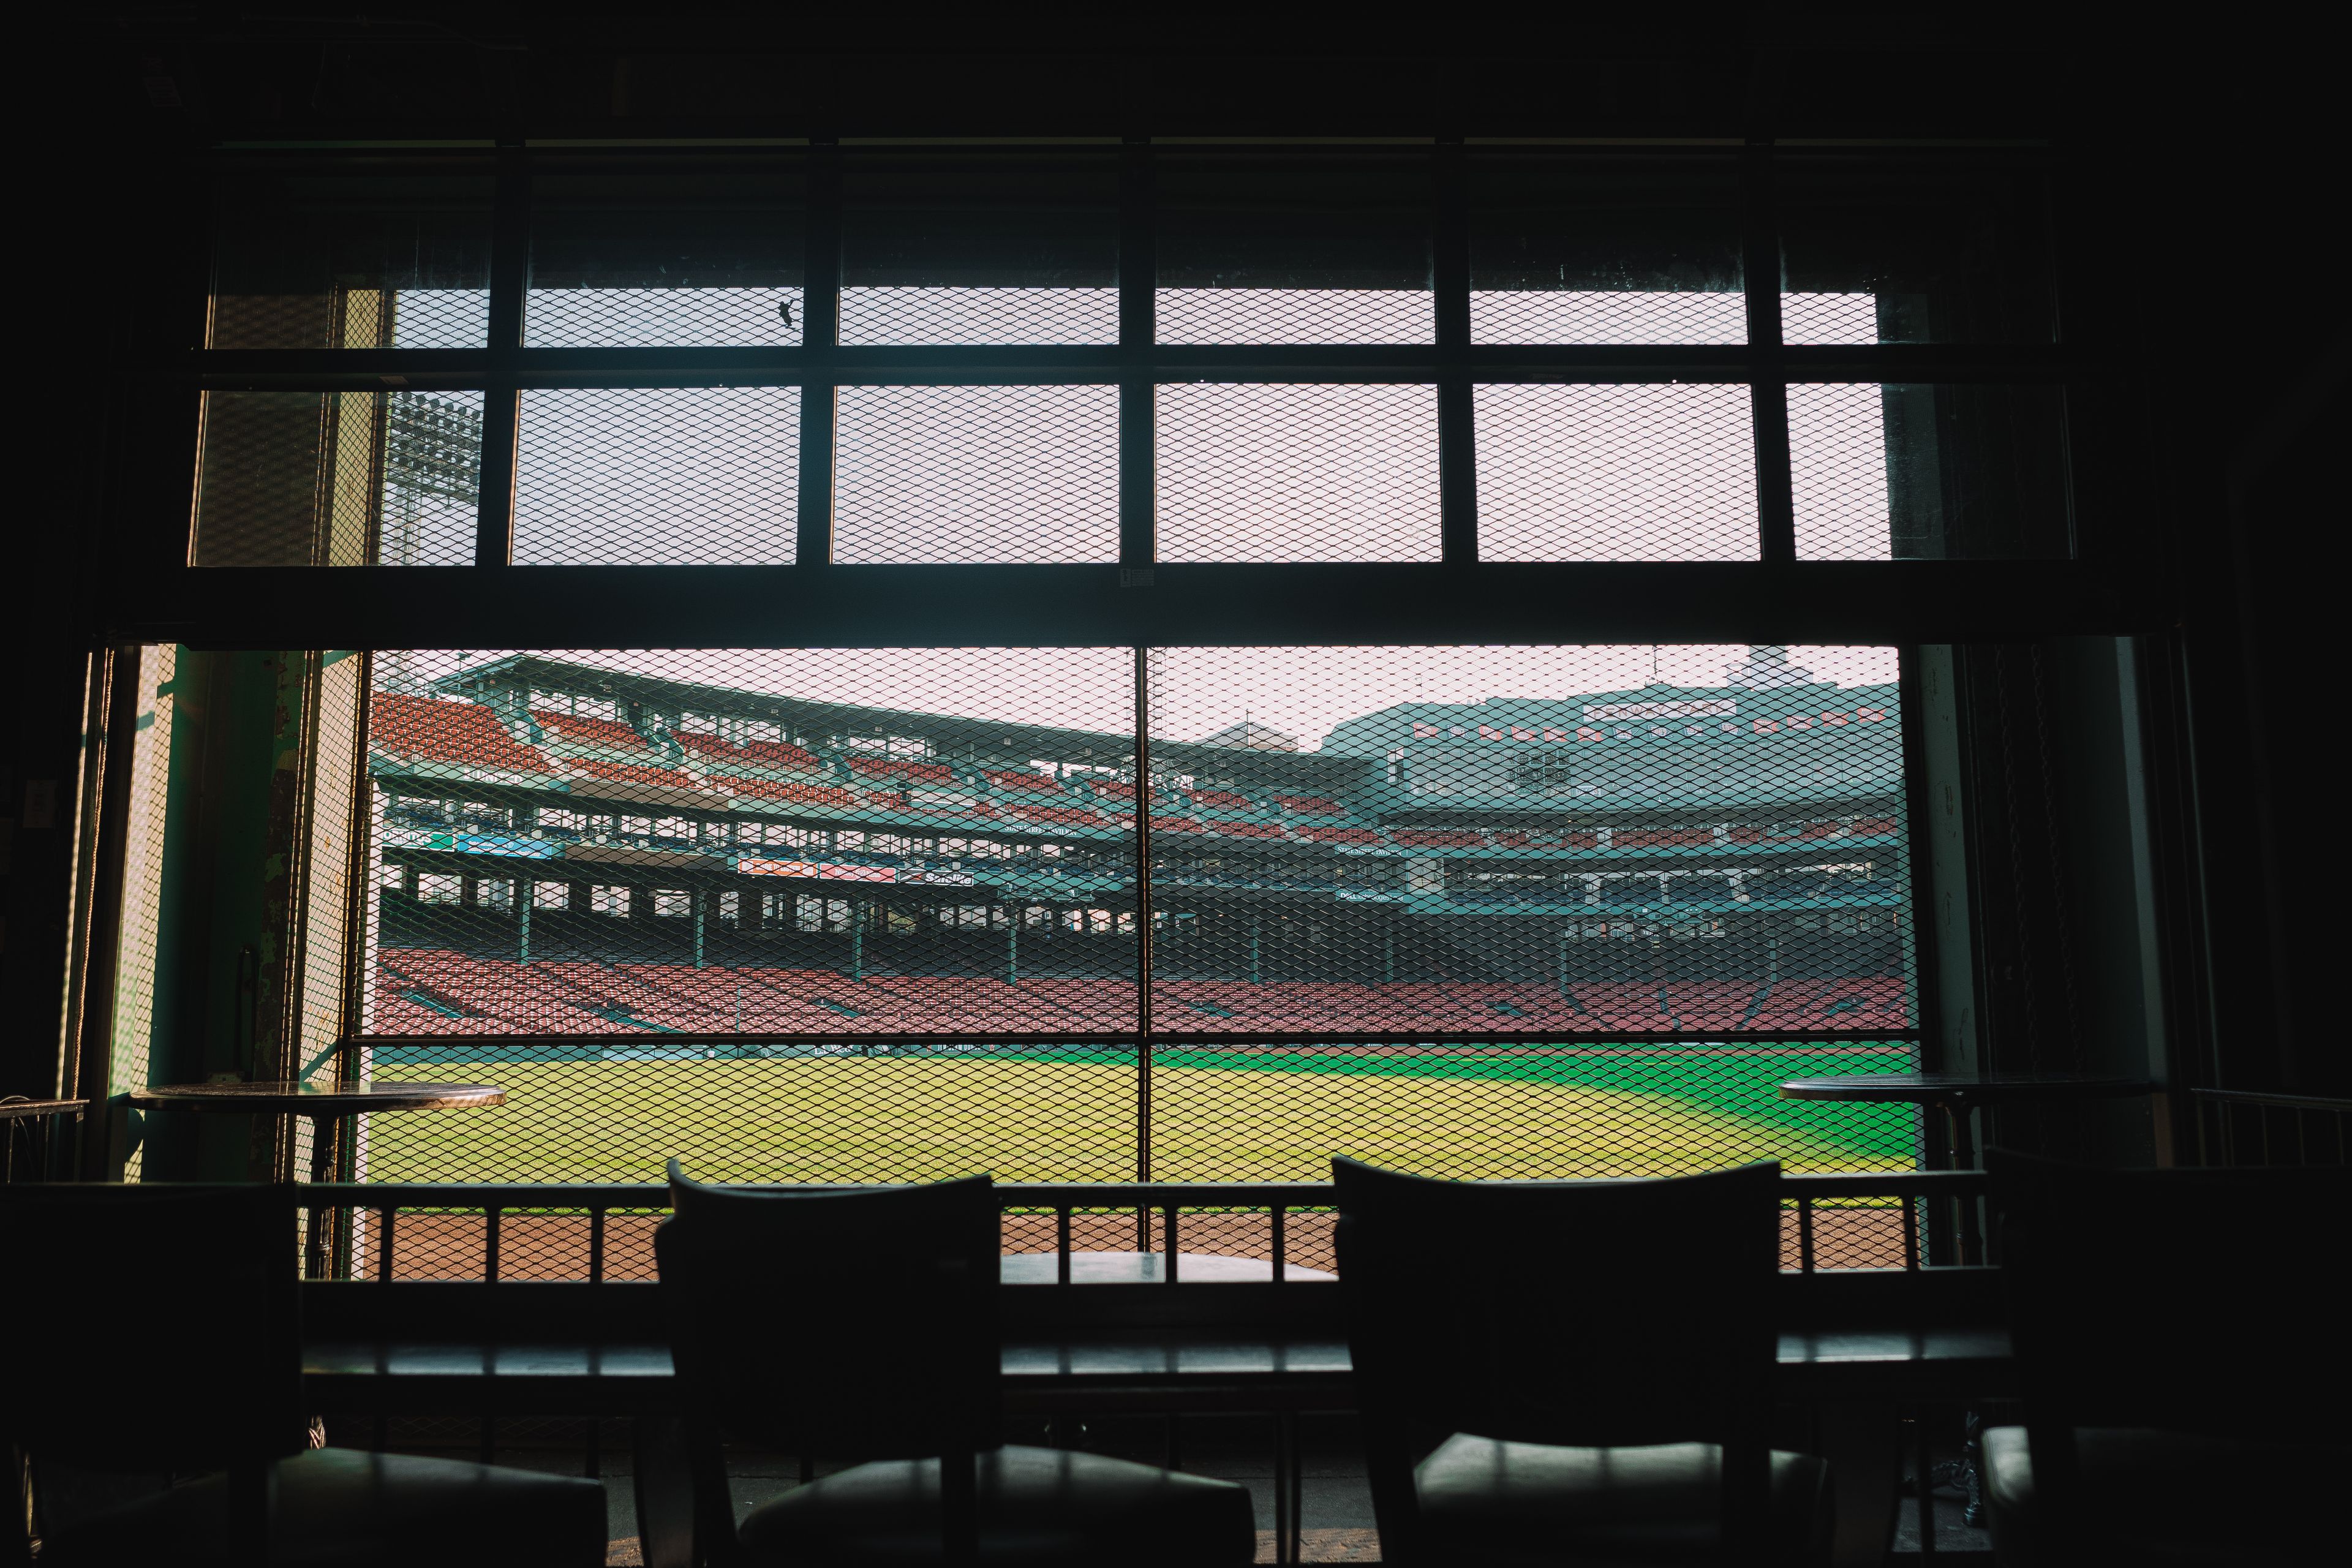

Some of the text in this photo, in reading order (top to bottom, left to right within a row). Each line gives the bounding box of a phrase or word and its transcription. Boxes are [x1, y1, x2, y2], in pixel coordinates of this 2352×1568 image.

[1593, 702, 1725, 718] FENWAY PARK
[1023, 825, 1047, 834] STREET
[1048, 827, 1077, 835] PAVILION
[925, 872, 971, 884] Safelite
